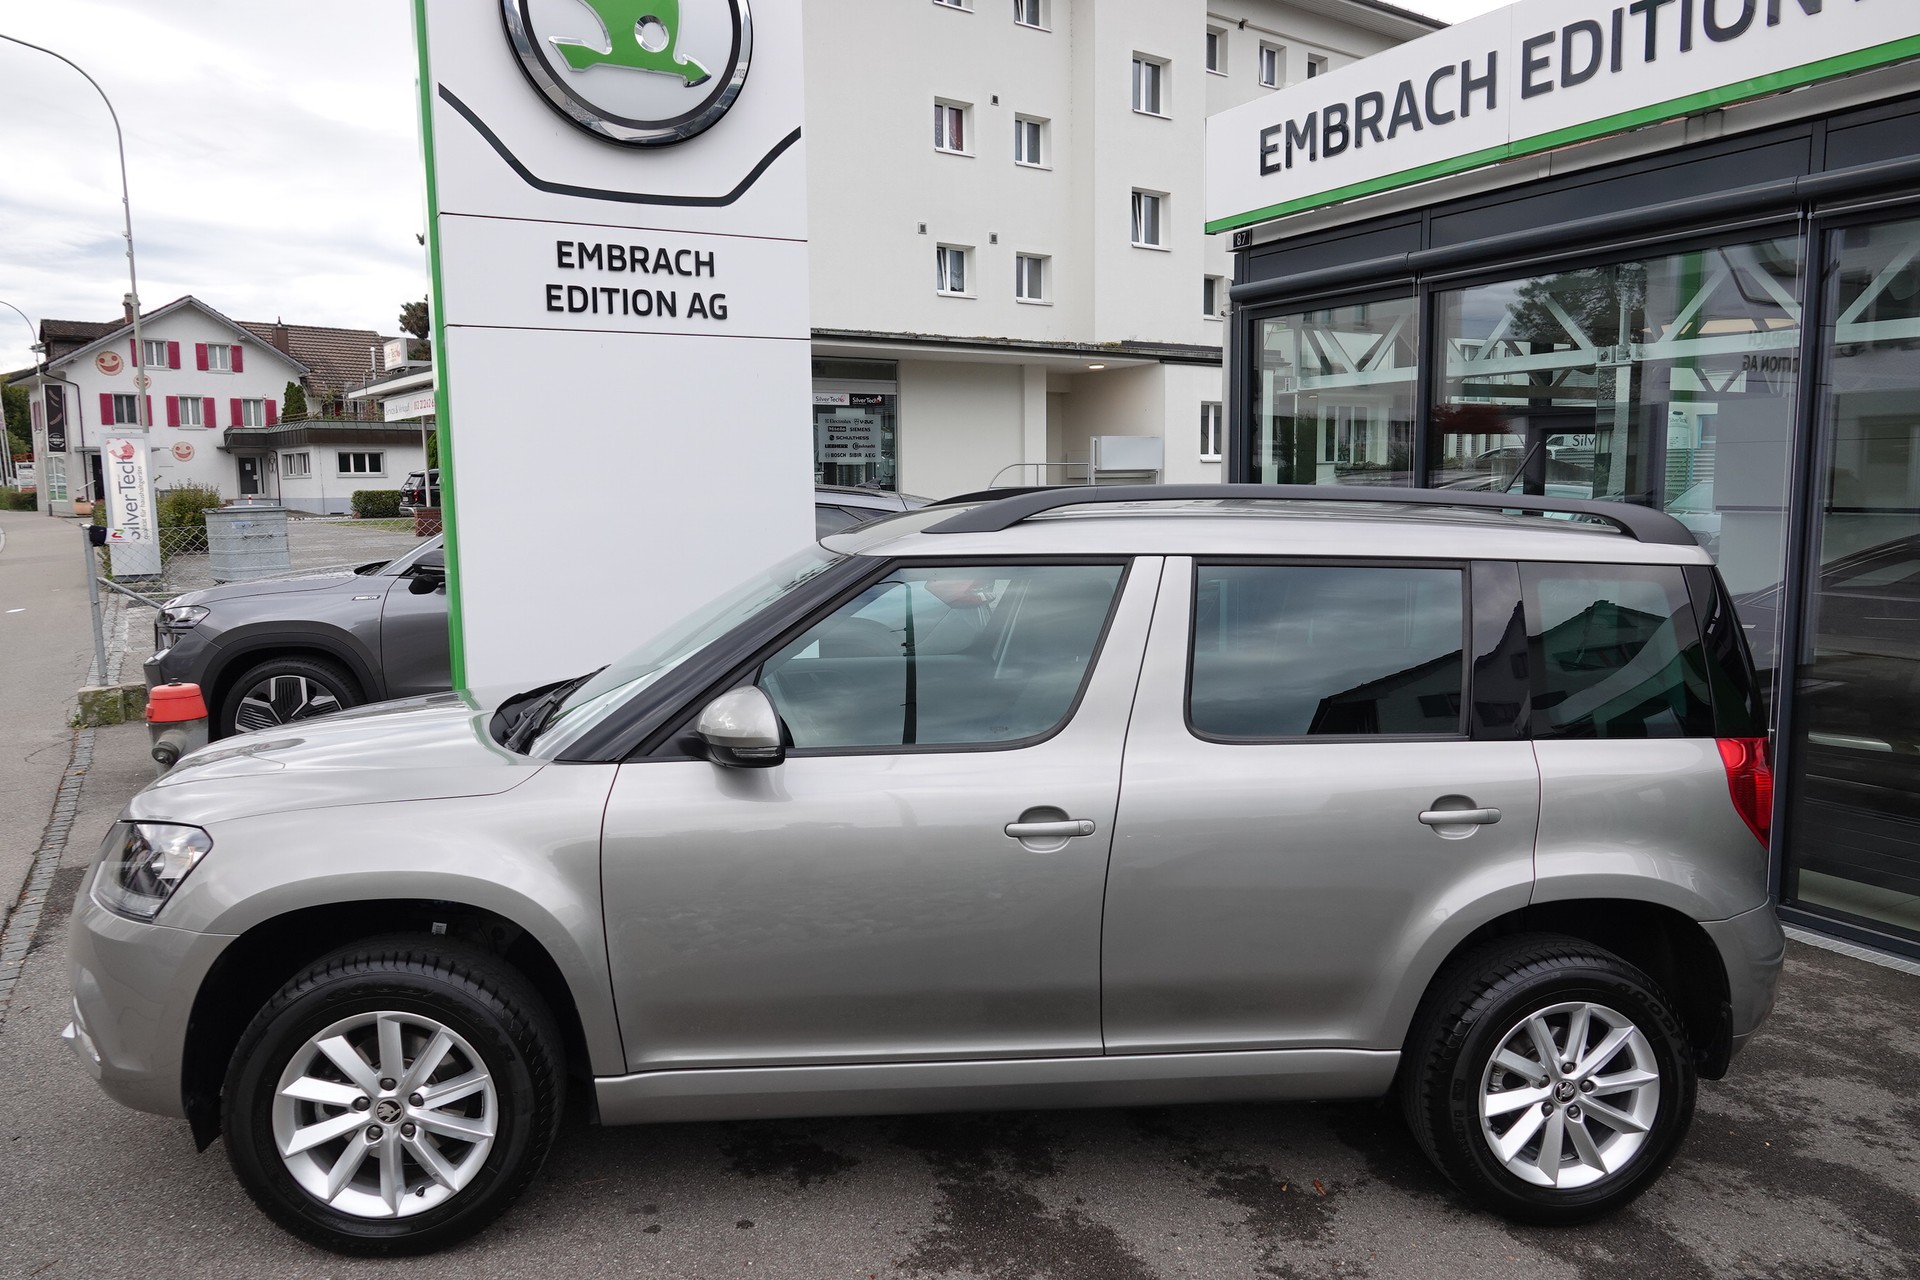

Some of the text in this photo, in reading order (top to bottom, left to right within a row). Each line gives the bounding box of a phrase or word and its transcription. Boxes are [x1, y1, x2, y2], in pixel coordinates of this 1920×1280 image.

[1260, 0, 1822, 176] EMBRACH EDITIO
[1236, 233, 1247, 246] 87
[557, 240, 715, 278] EMBRACH
[546, 284, 728, 320] EDITION AG
